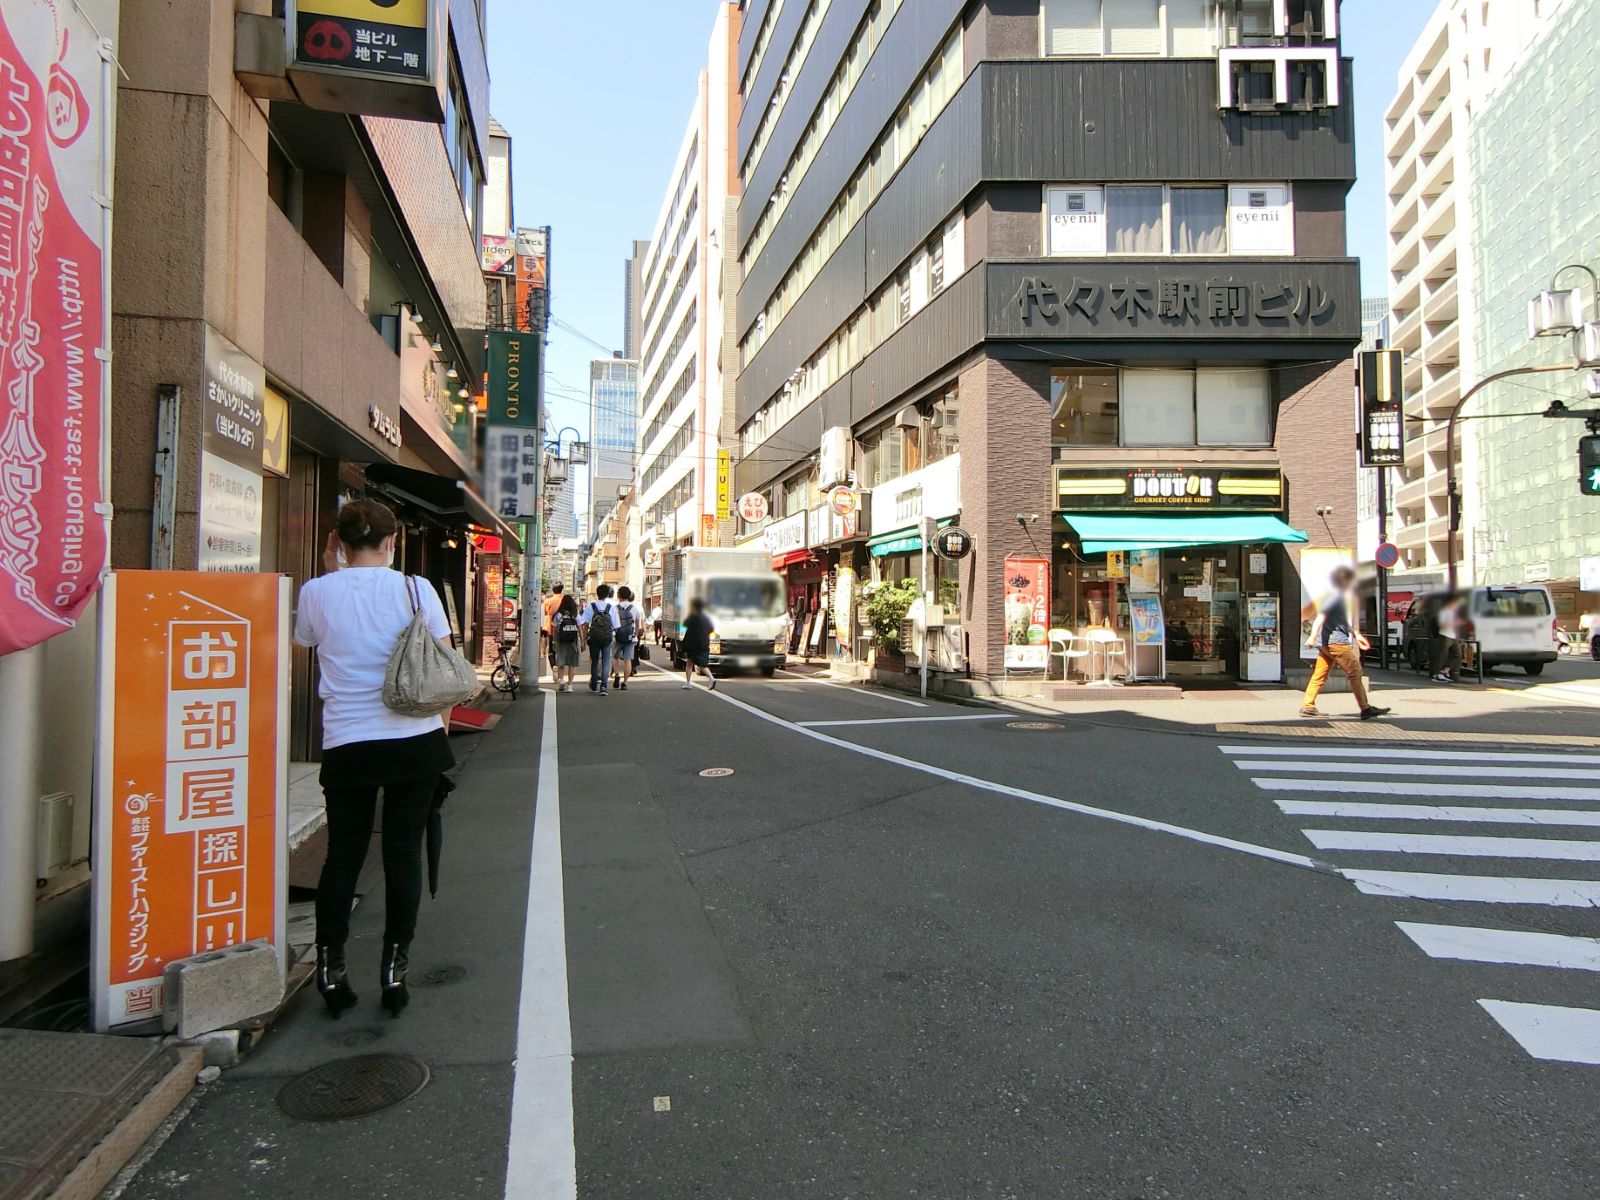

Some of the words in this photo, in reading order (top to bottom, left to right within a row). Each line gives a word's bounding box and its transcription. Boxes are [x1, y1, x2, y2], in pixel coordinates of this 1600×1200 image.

[355, 28, 398, 47] 当ビル
[354, 46, 419, 68] 地下一階
[1054, 211, 1098, 227] eyenii
[1236, 209, 1279, 223] eyenii
[1012, 275, 1334, 321] 代々木駅前ビル
[218, 359, 255, 401] 代々木駅前
[506, 339, 521, 420] PRONTO
[208, 380, 262, 428] さかいクリニック
[521, 433, 535, 487] 自転車
[1133, 474, 1213, 497] DOUTOR
[562, 624, 578, 632] VANS
[179, 630, 239, 950] お部屋探し!!
